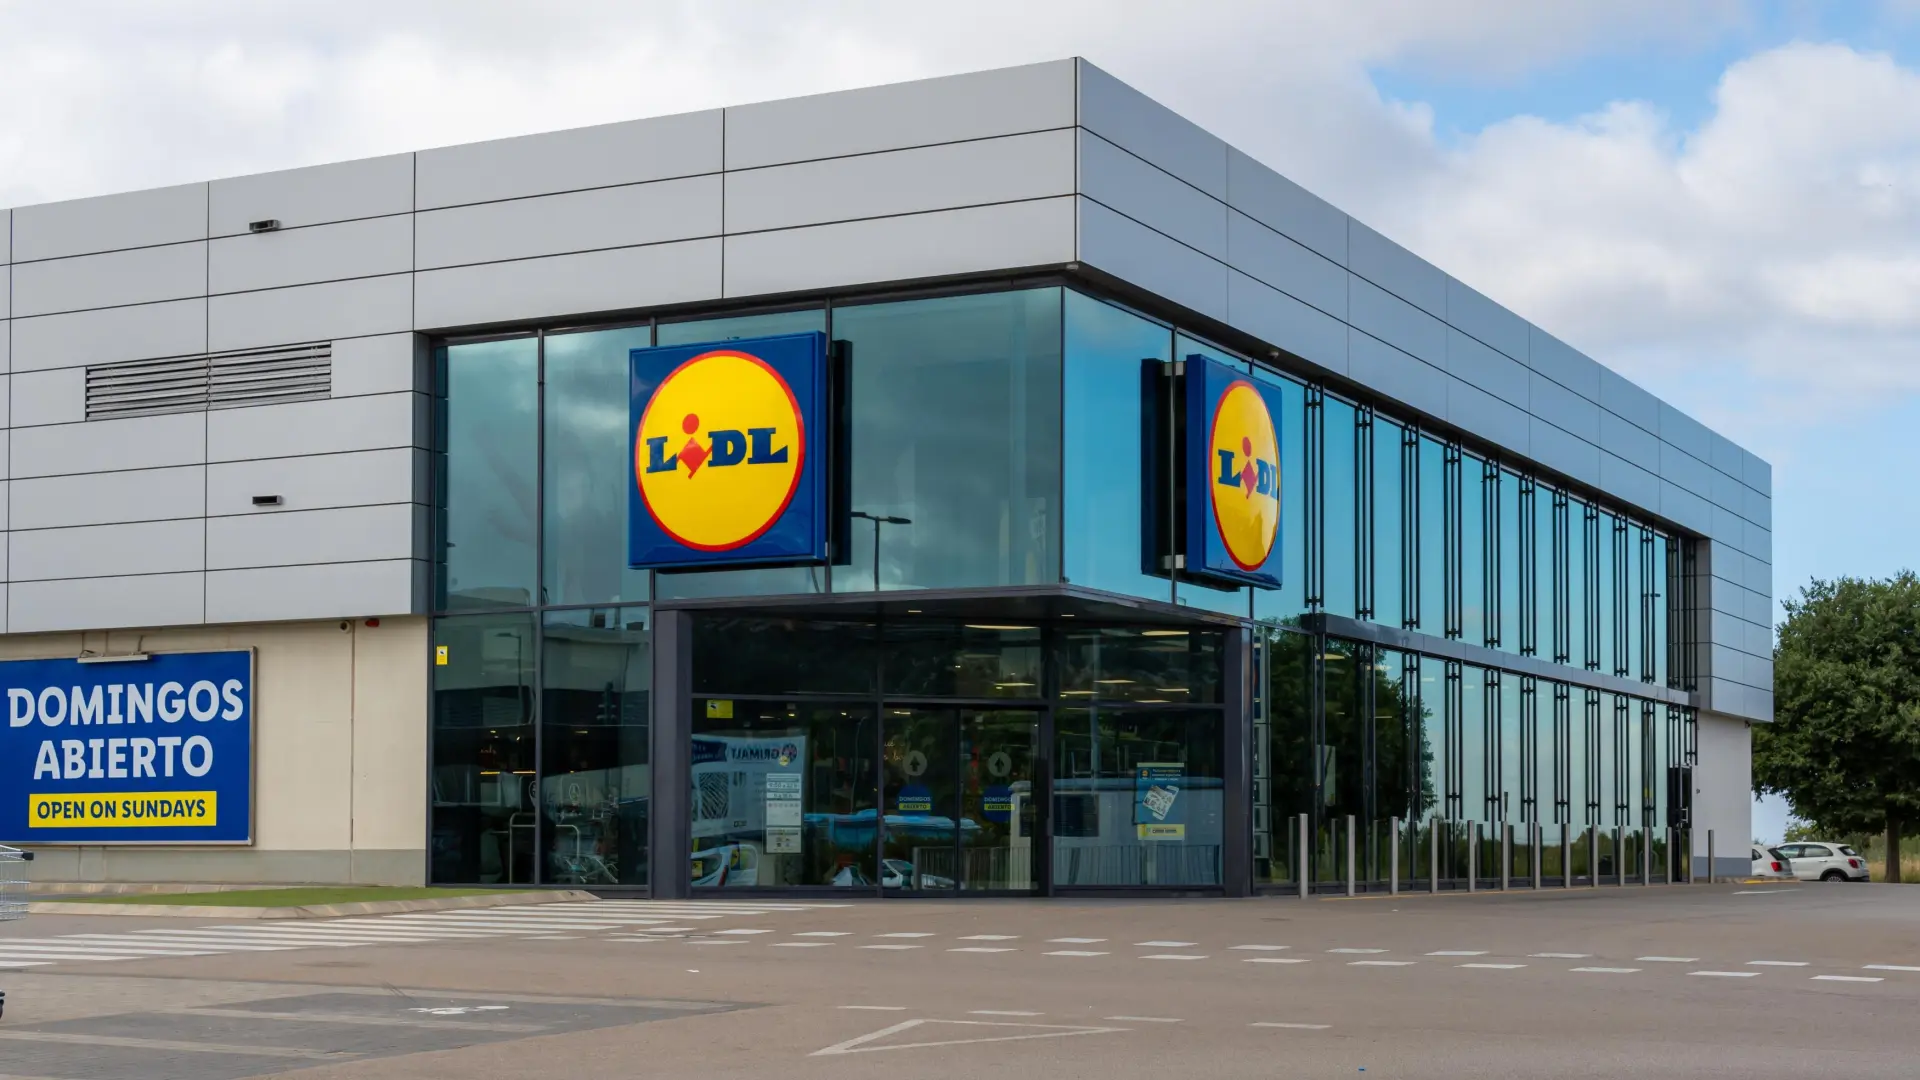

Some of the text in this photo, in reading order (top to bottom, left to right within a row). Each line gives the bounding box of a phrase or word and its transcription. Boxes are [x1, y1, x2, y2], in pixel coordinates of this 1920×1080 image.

[646, 413, 788, 480] LIDL
[7, 679, 244, 727] DOMINGOS
[33, 735, 213, 780] ABIERTO
[37, 799, 206, 819] OPEN ON SUNDAYS
